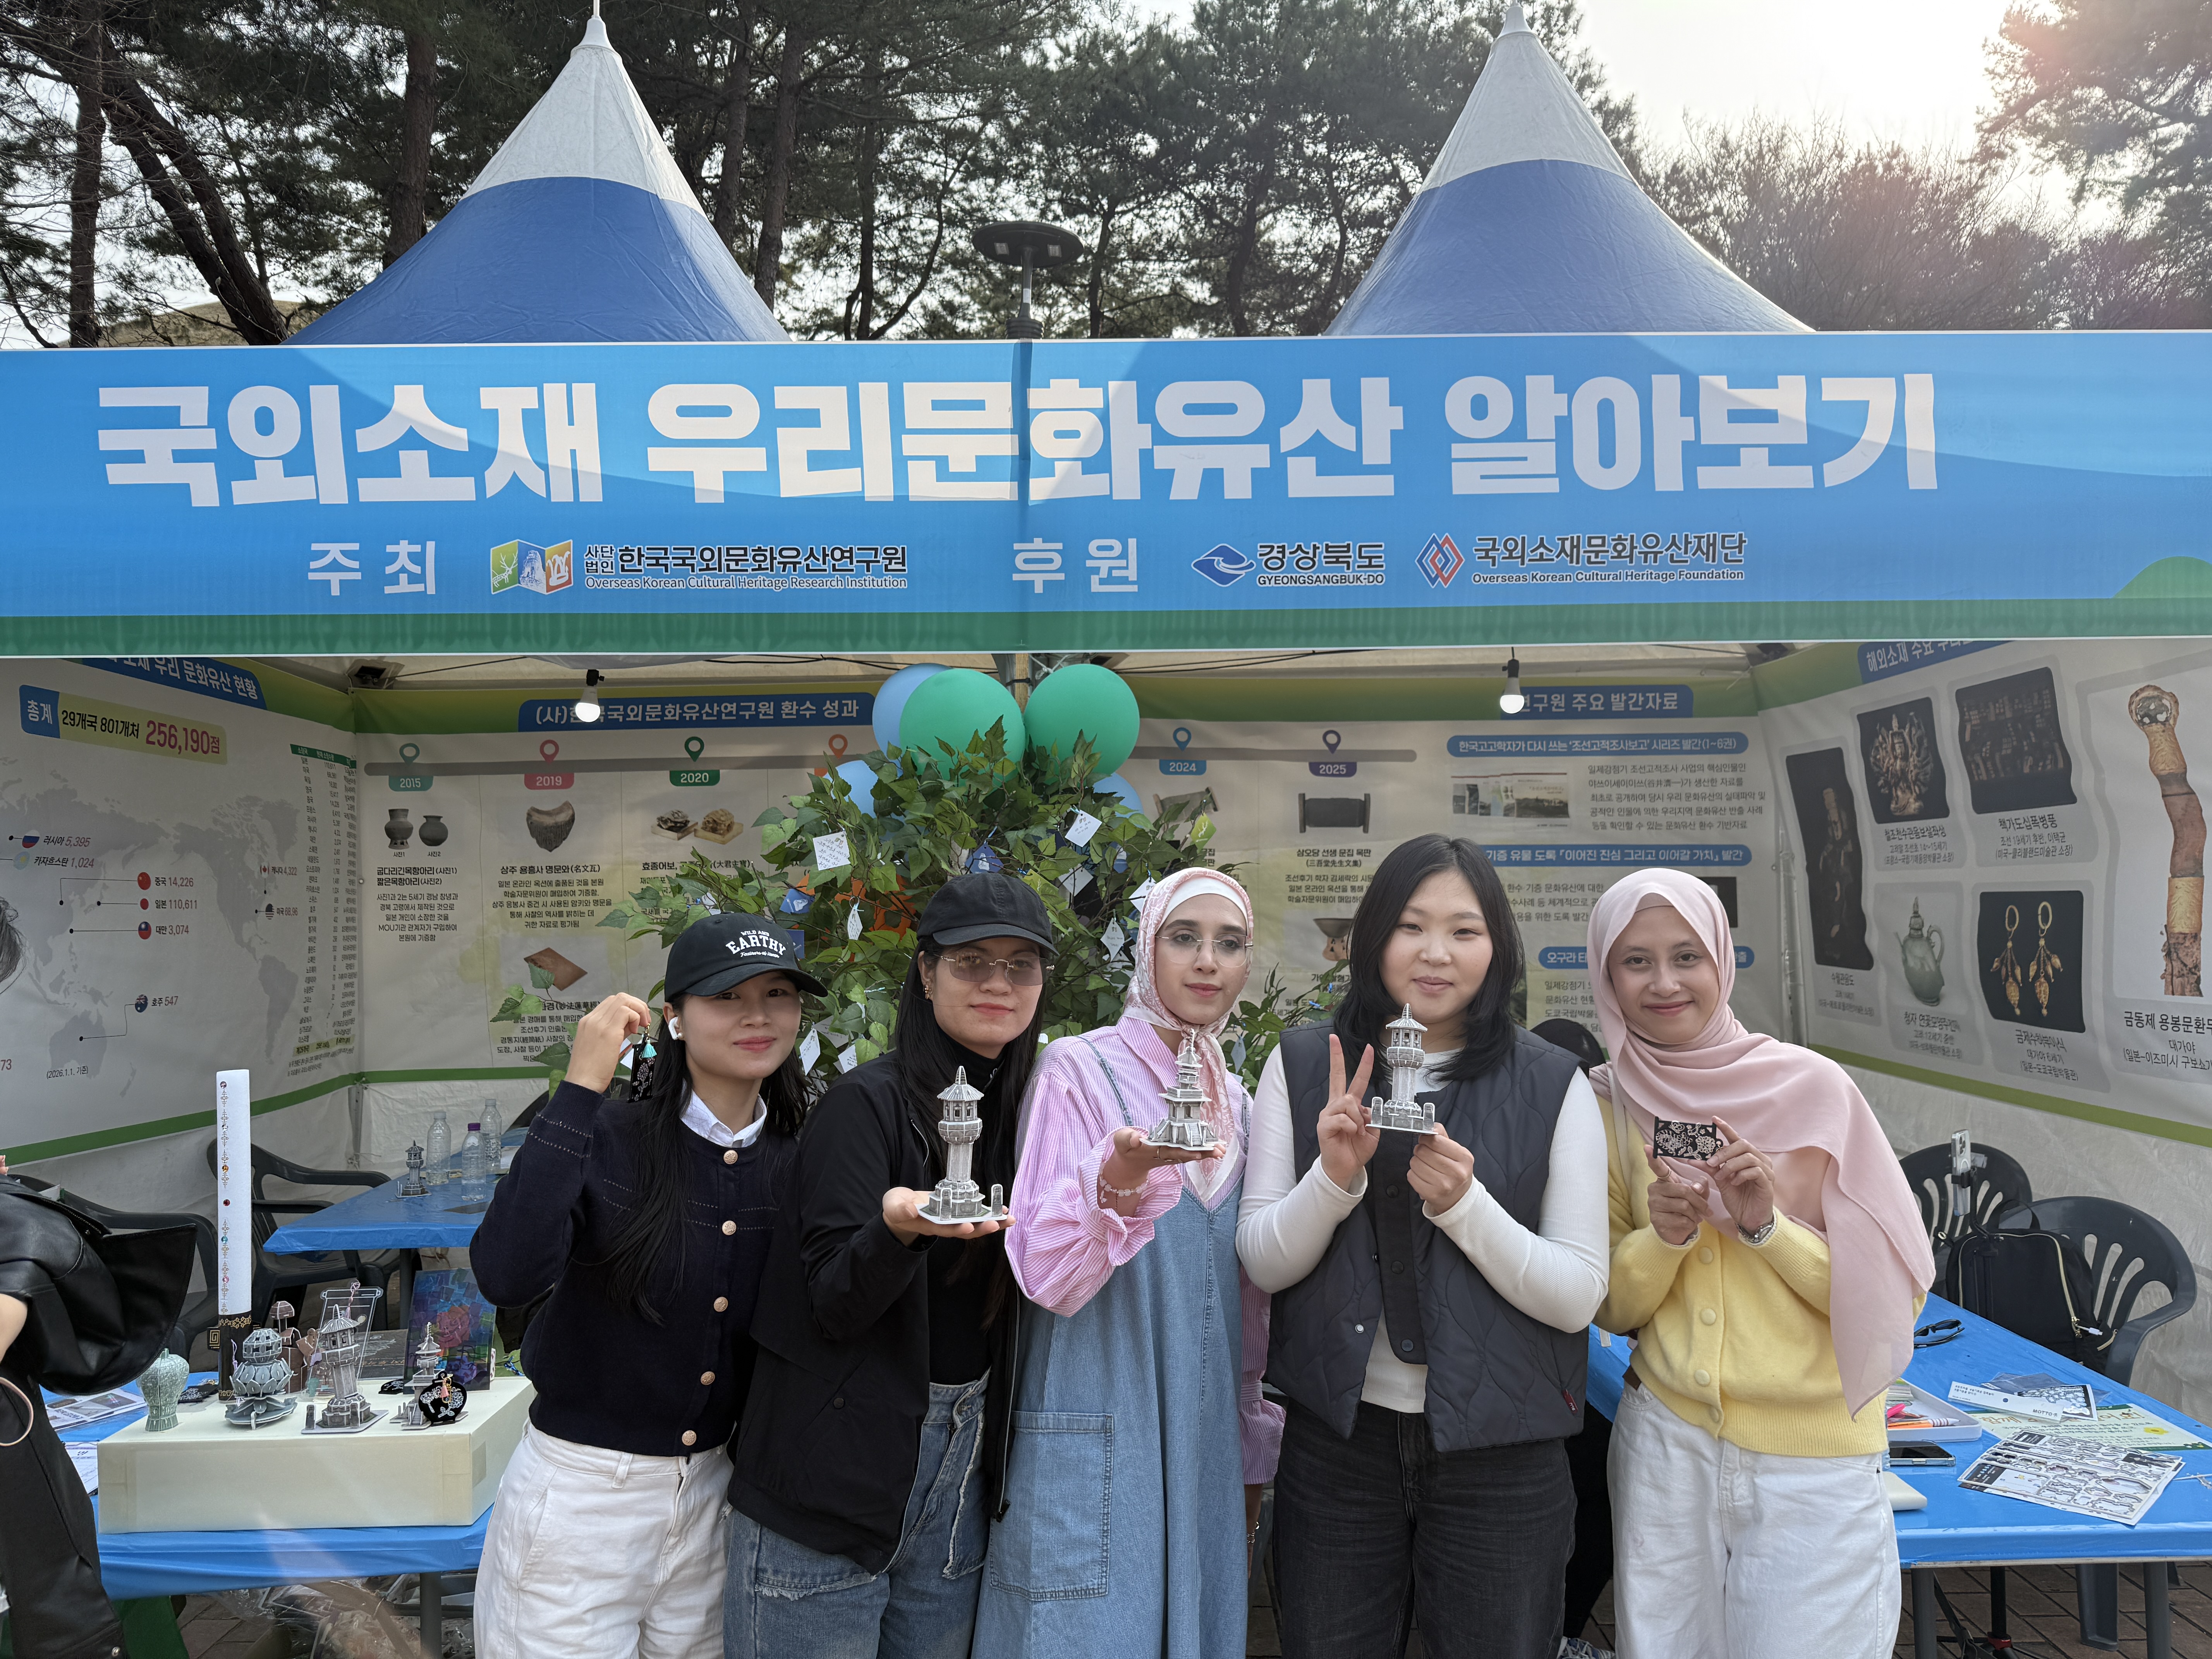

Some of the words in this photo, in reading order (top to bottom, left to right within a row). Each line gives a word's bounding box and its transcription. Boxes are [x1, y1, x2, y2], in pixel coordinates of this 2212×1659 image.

[98, 382, 603, 507] 국외소재
[647, 377, 1404, 504] 우리문화유산
[1444, 373, 1937, 494] 알아보기
[585, 545, 615, 558] 사단
[1474, 533, 1747, 567] 국외소재문화유산재단
[618, 546, 907, 574] 한국국외문화유산연구원
[1259, 543, 1384, 571] 경상북도
[308, 543, 361, 596] 주
[384, 540, 435, 594] 최
[586, 561, 614, 574] 법인
[1013, 538, 1065, 593] 후
[1086, 538, 1138, 592] 원
[1259, 574, 1384, 585] GYEONGSANGBUK-DO
[1473, 573, 1527, 583] Overseas
[1531, 573, 1571, 582] Korean
[1575, 571, 1622, 582] Cultural
[1626, 571, 1675, 582] Heritage
[1679, 570, 1743, 580] Foundation
[586, 577, 641, 588] Overseas
[644, 577, 684, 588] Korean
[688, 577, 735, 588] Cultural
[738, 577, 787, 591] Heritage
[790, 577, 843, 588] Research
[847, 577, 907, 588] Institution
[155, 658, 180, 679] 우리
[183, 660, 232, 693] 문화유산
[233, 675, 258, 700] 현황
[1572, 692, 1604, 711] 주요
[1611, 692, 1677, 710] 발간자료
[781, 701, 816, 718] 환수
[823, 700, 859, 718] 성과
[27, 700, 53, 724] 총계
[62, 709, 97, 732] 29개국
[100, 717, 139, 738] 801개처
[146, 720, 220, 755] 256,190점
[1460, 740, 1525, 752] 한국고고학자가
[1528, 740, 1546, 752] 다시
[1548, 740, 1567, 752] 쓰는
[1652, 739, 1680, 750] 시리즈
[1169, 762, 1197, 772] 2024
[1319, 764, 1346, 775] 2025
[400, 778, 421, 788] 2015
[536, 776, 562, 786] 2019
[681, 773, 709, 783] 2020
[43, 836, 64, 846] 러시아
[65, 836, 91, 847] 5,395
[34, 856, 69, 867] 카자흐스탄
[70, 857, 94, 869] 1,024
[642, 862, 677, 871] 효종어보,
[155, 877, 167, 887] 중국
[168, 877, 194, 888] 14,226
[155, 900, 167, 909] 일본
[169, 900, 198, 910] 110,611
[156, 925, 167, 935] 대만
[168, 924, 189, 936] 3,074
[725, 935, 786, 955] EARTHY
[1547, 952, 1576, 963] 오구라
[151, 998, 163, 1006] 호주
[165, 996, 179, 1006] 547
[2124, 1011, 2155, 1029] 금동제
[2169, 1039, 2195, 1054] 대가야
